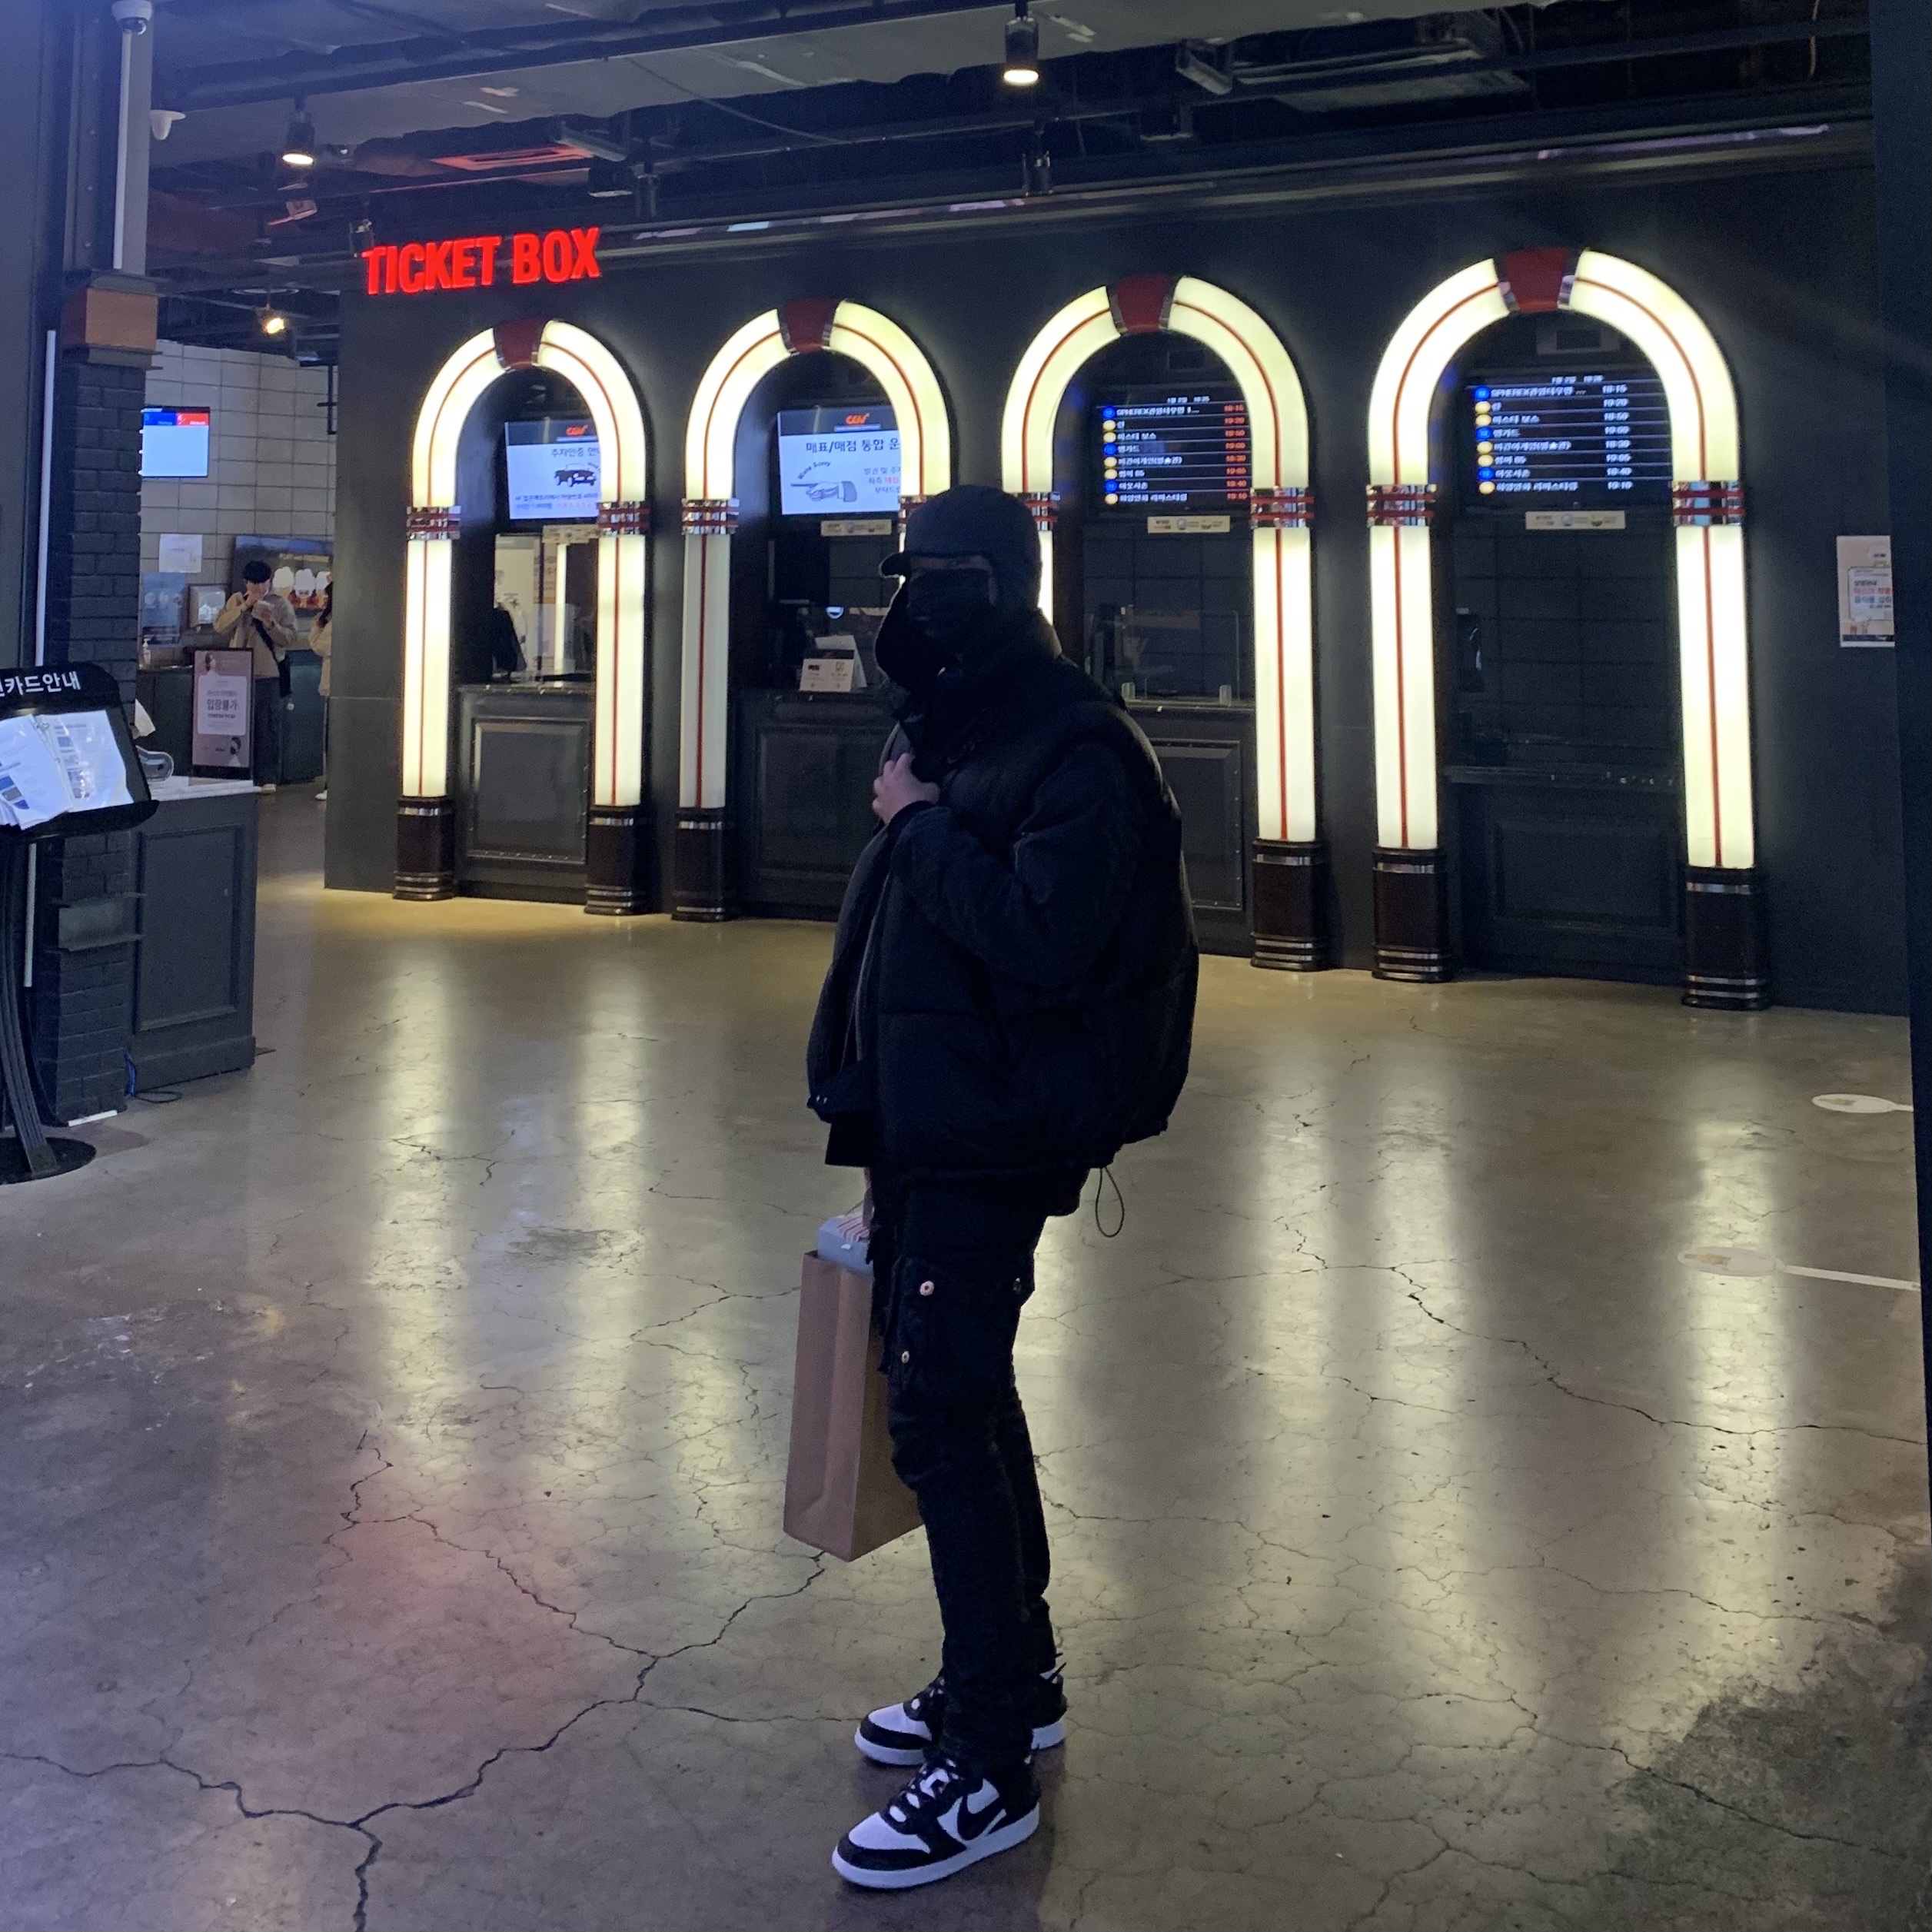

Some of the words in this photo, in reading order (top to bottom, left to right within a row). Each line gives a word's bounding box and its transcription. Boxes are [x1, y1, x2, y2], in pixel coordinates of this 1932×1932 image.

[361, 235, 502, 295] TICKET
[512, 227, 602, 284] BOX
[550, 447, 584, 457] 주차인증
[587, 446, 600, 457] 안
[806, 440, 857, 454] 매표/매점
[862, 440, 884, 451] 통합
[206, 699, 238, 711] 입장불가
